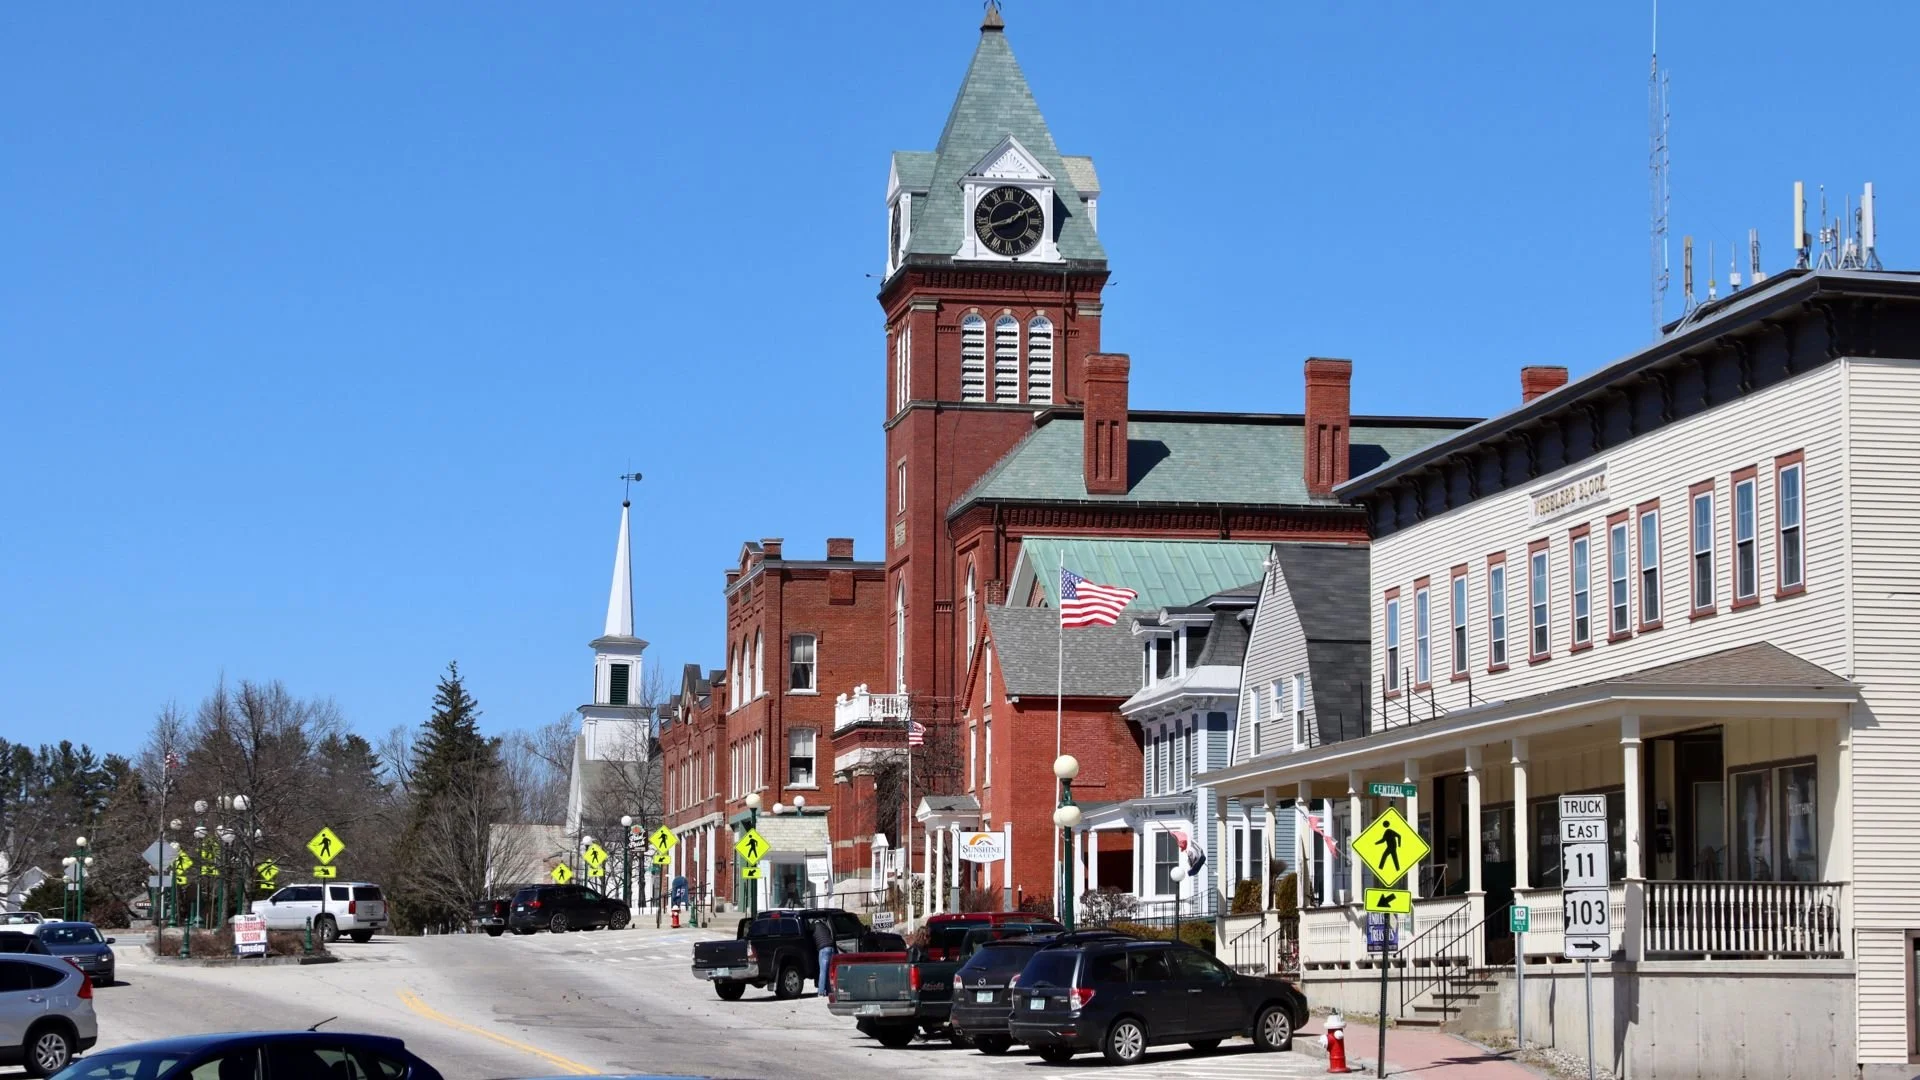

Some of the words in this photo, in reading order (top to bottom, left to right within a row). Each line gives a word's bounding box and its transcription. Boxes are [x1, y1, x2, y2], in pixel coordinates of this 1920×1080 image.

[1579, 474, 1606, 499] BLOCK
[1373, 784, 1404, 795] CENTRAL
[1563, 800, 1602, 814] TRUCK
[1568, 823, 1600, 839] EAST
[1575, 852, 1594, 878] 11
[1570, 900, 1606, 926] 103
[242, 932, 261, 942] SESSION
[239, 944, 265, 953] Tuesday
